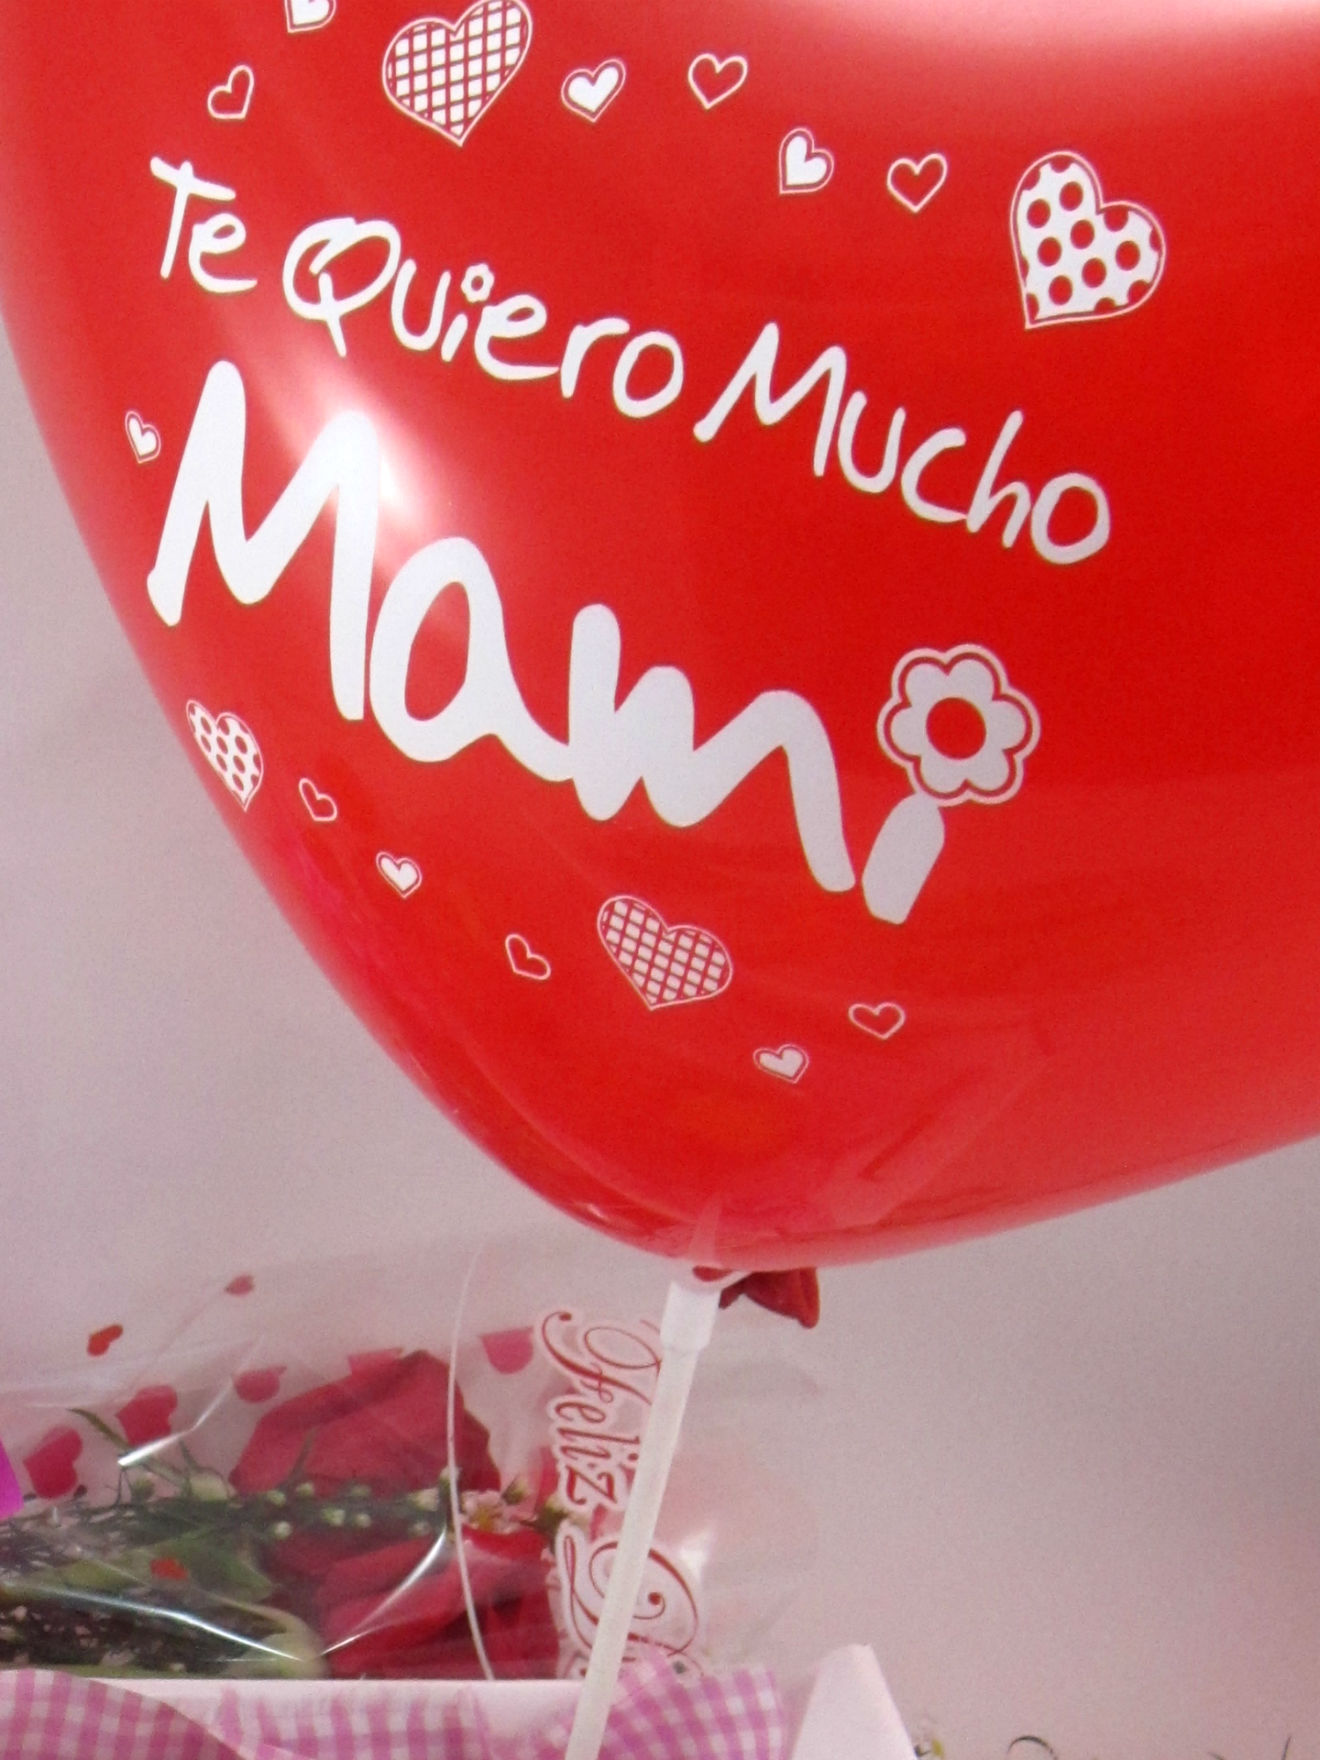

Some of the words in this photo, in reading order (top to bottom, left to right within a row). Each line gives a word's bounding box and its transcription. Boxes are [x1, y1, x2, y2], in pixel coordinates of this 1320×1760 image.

[150, 156, 258, 292] Te
[282, 216, 684, 418] Quiero
[692, 322, 1111, 564] Mucho
[146, 360, 1040, 925] Mami
